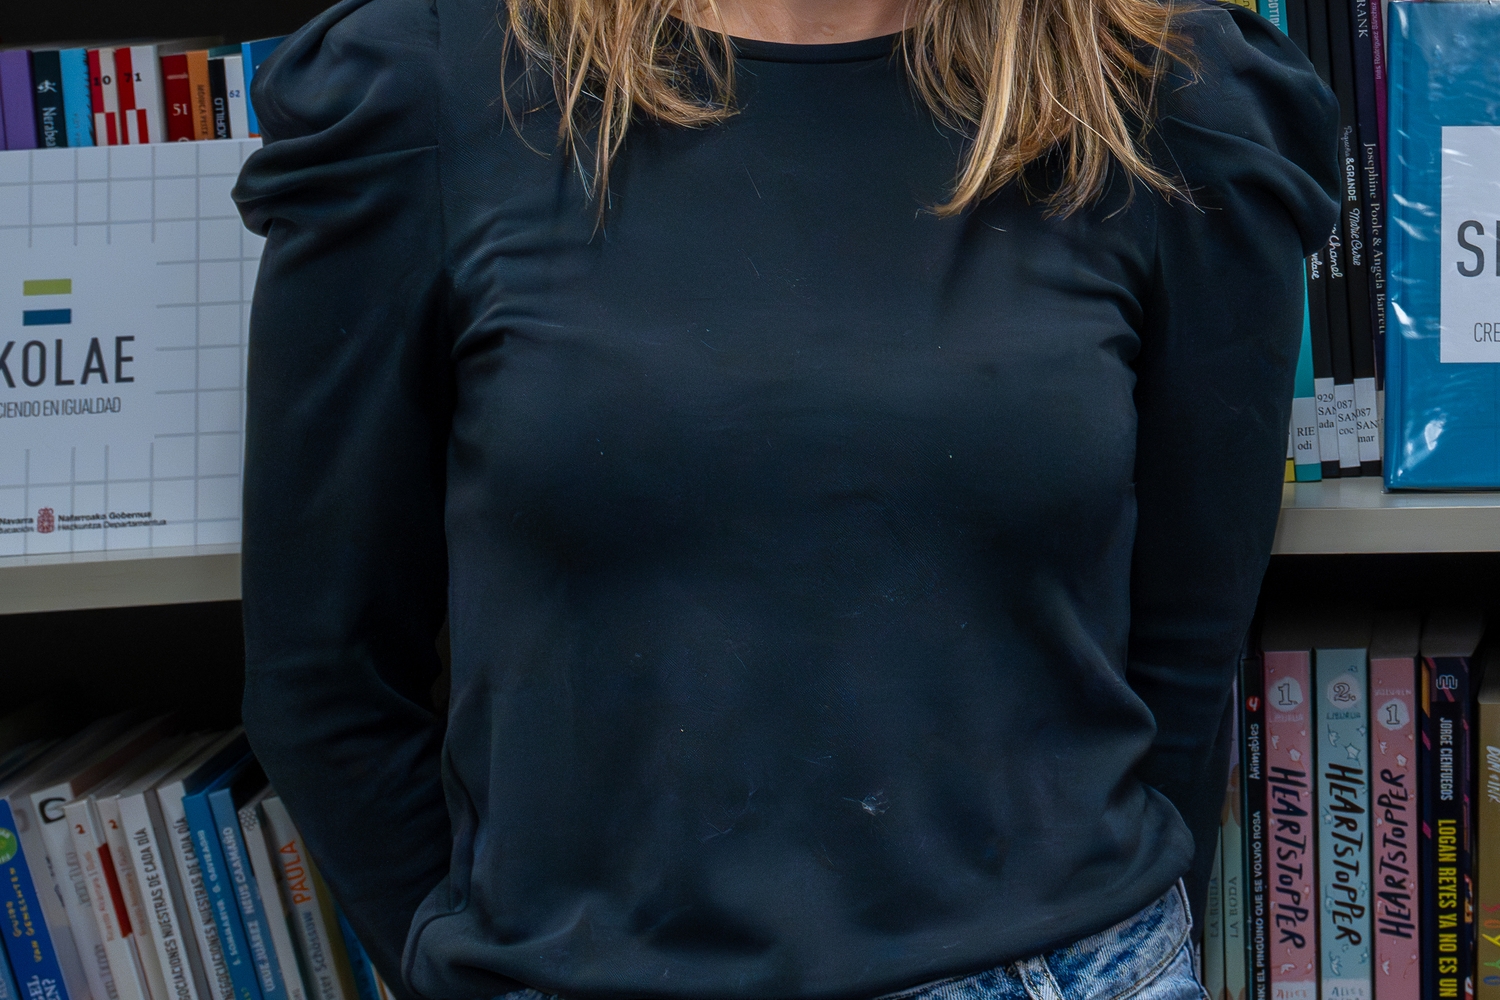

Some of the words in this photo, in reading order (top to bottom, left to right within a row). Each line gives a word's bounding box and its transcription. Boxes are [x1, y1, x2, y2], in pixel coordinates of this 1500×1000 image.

[173, 104, 187, 116] 51
[1363, 143, 1376, 198] Josephine
[1370, 204, 1380, 236] Poole
[1370, 249, 1385, 289] Angela
[0, 336, 134, 388] KOLAE
[43, 400, 59, 416] EN
[61, 397, 121, 415] IGUALDAD
[1440, 717, 1452, 745] JORGE
[1440, 750, 1453, 801] CIENFUEGOS
[1269, 766, 1308, 949] HEARTSTOPPER
[1325, 763, 1365, 945] HEARTSTOPPER
[1378, 769, 1415, 939] HEARTSTOPPER
[1438, 819, 1457, 858] LOGAN
[281, 840, 311, 905] PAULA
[1438, 864, 1457, 908] REYES
[1438, 912, 1457, 929] YA
[1438, 933, 1457, 952] NO
[1438, 955, 1458, 972] ES
[1438, 977, 1458, 997] UN
